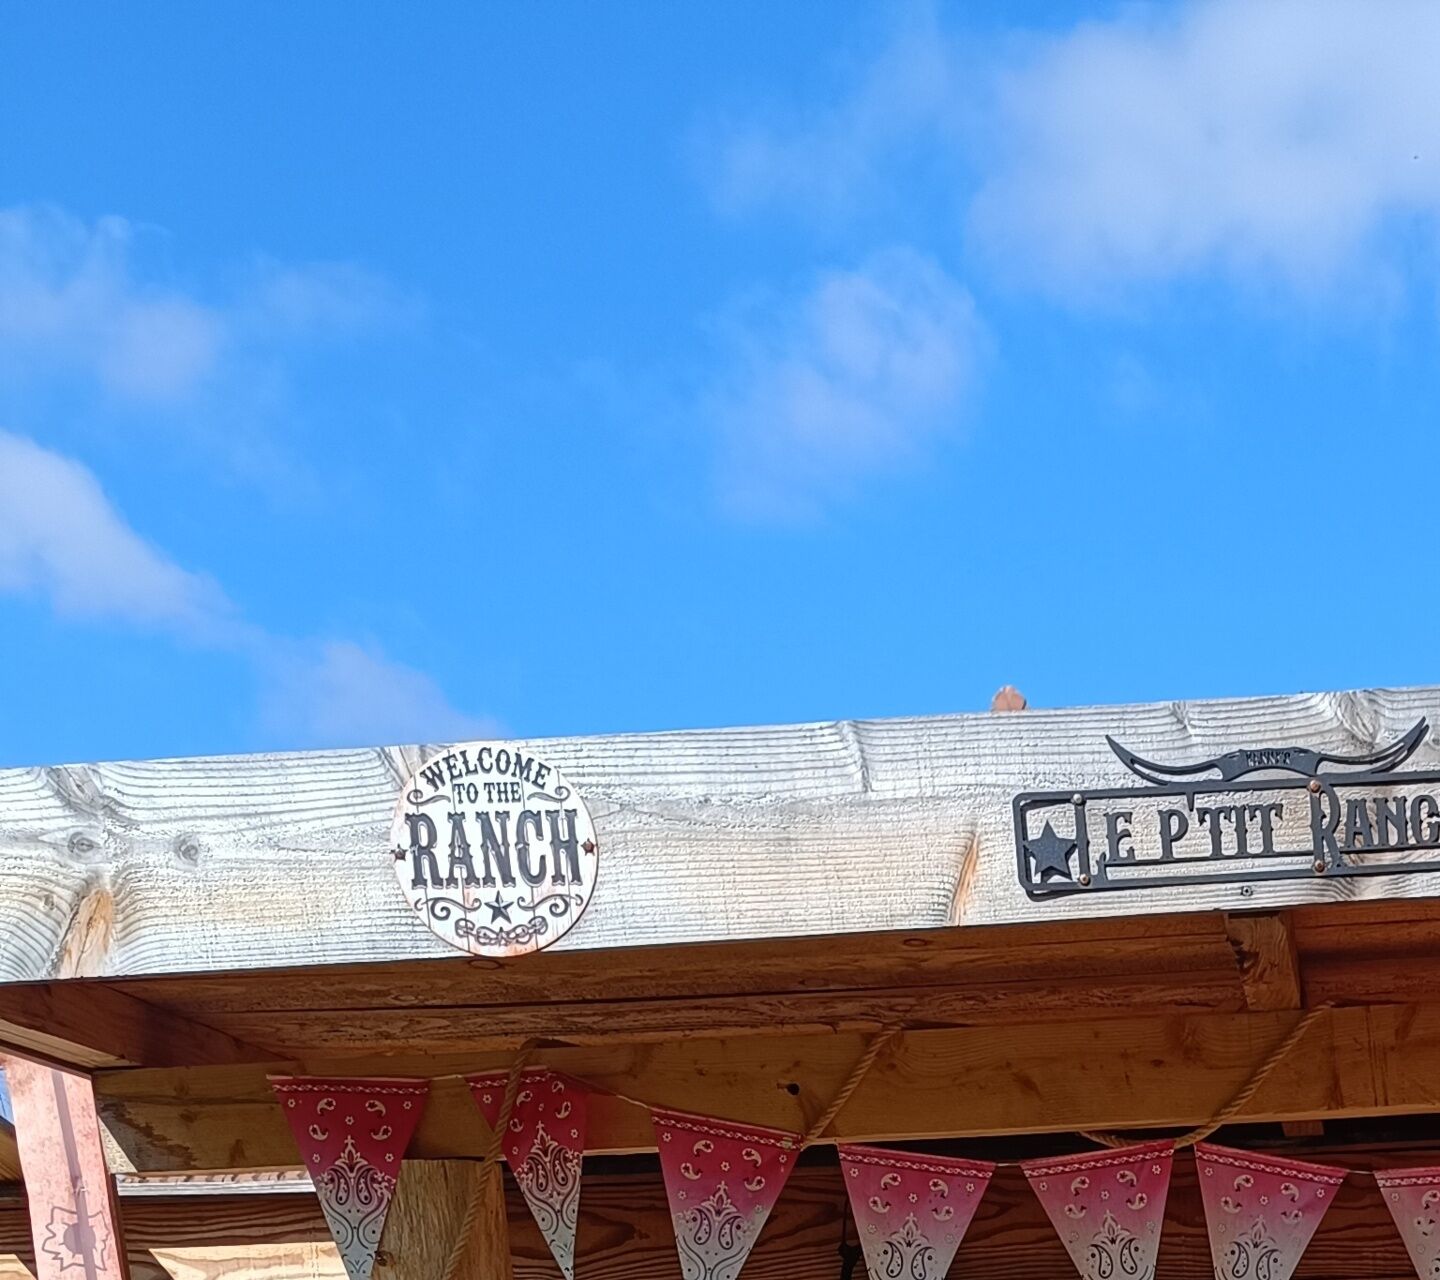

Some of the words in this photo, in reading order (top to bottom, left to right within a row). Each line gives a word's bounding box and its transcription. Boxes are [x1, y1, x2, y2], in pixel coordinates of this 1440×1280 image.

[420, 747, 551, 792] WELCOME
[454, 782, 479, 804] TO
[484, 781, 522, 803] THE
[405, 808, 583, 890] RANCH
[1158, 791, 1284, 862] P'TIT
